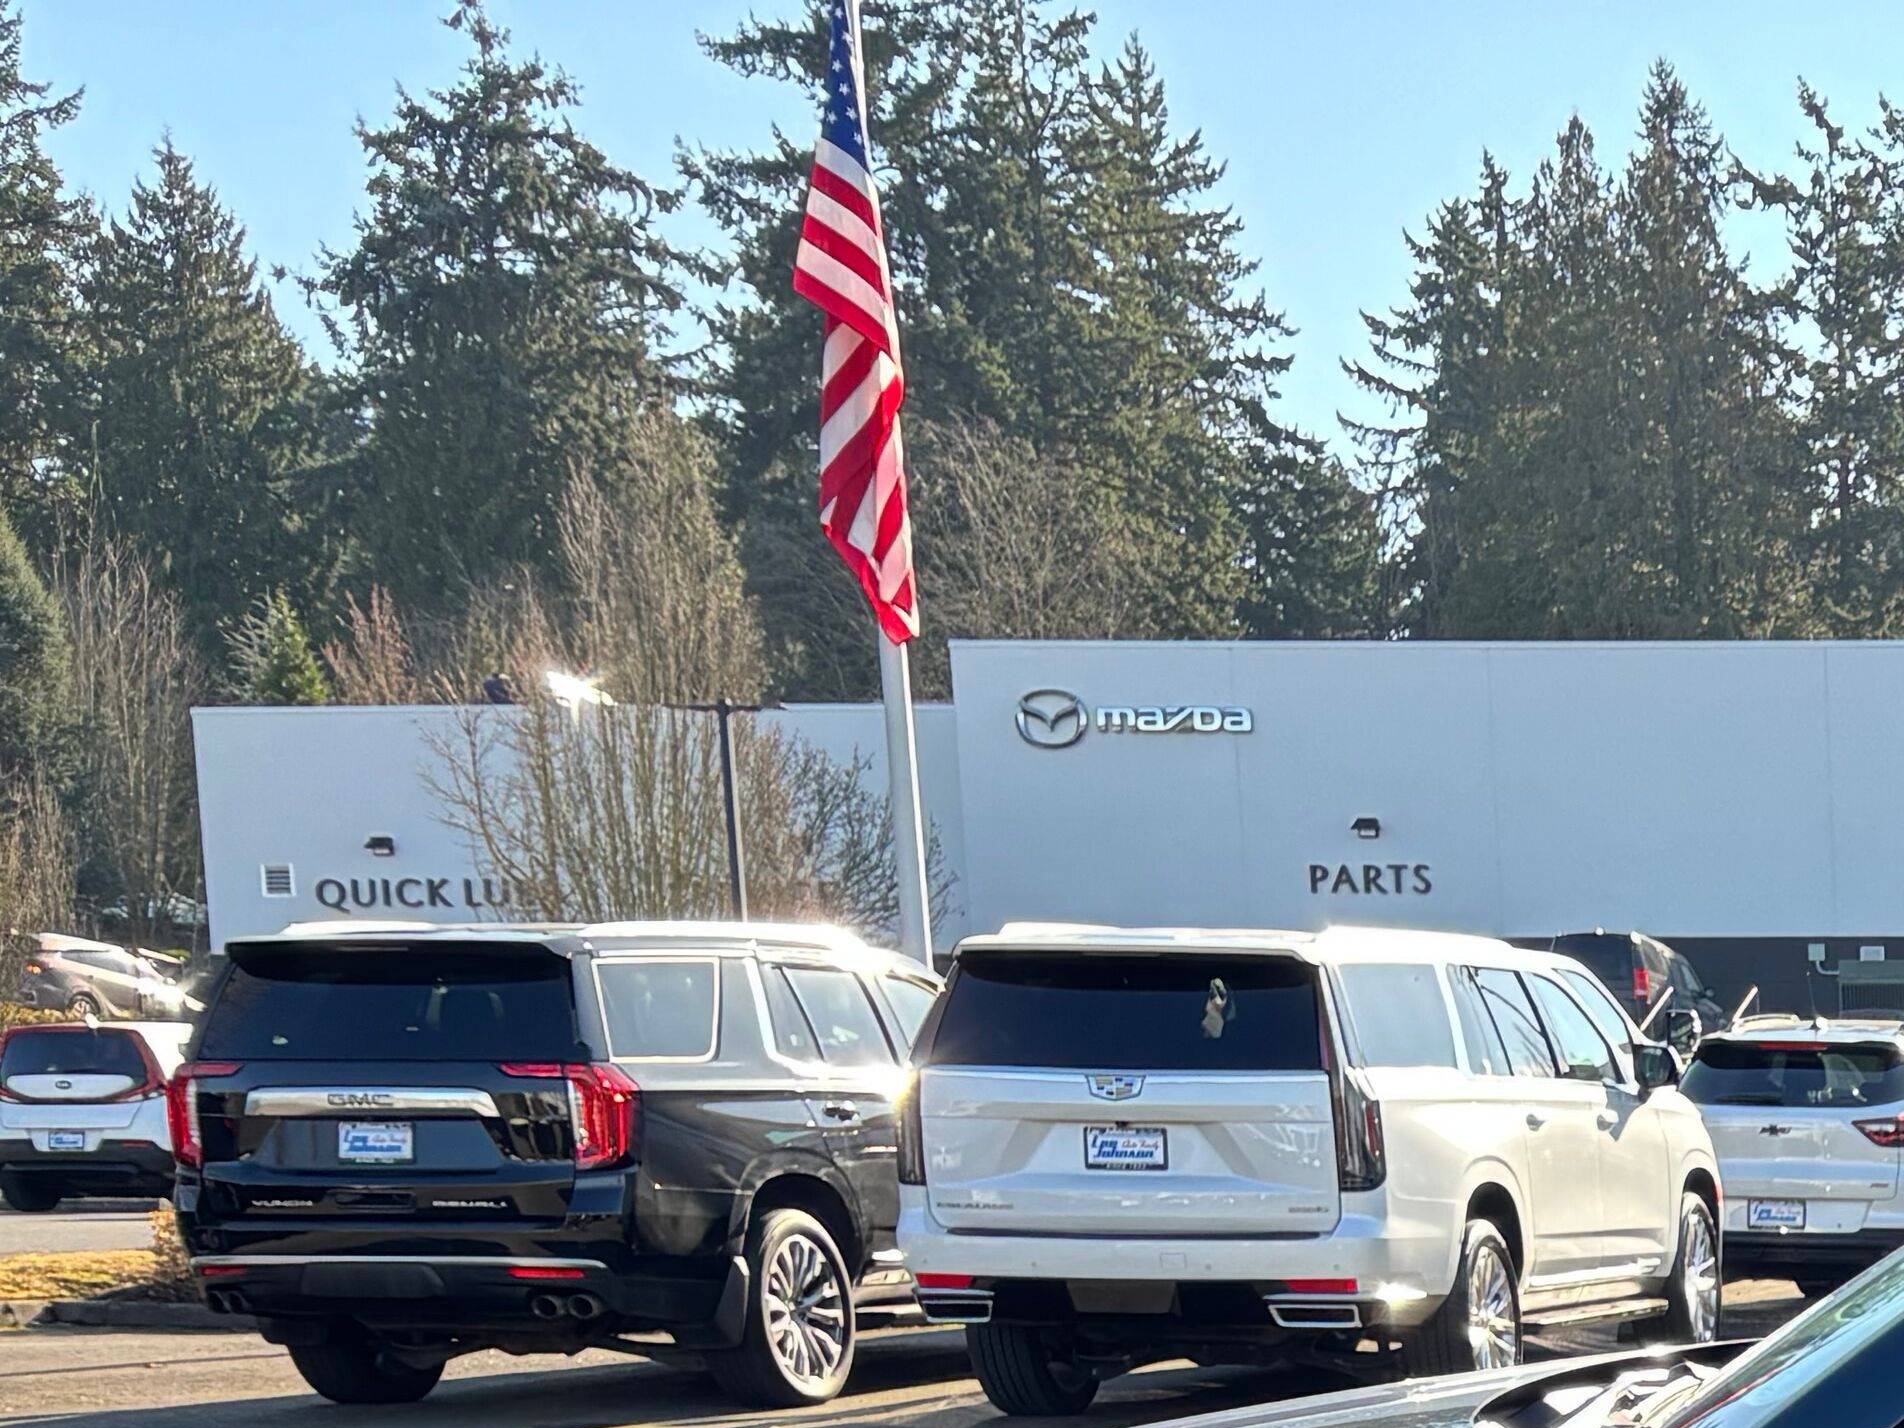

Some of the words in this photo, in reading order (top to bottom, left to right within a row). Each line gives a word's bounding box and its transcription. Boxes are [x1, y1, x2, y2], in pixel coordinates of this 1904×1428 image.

[1096, 706, 1253, 733] mazda
[1308, 863, 1433, 896] PARTS
[315, 877, 454, 914] QUICK
[327, 1092, 395, 1106] GMC
